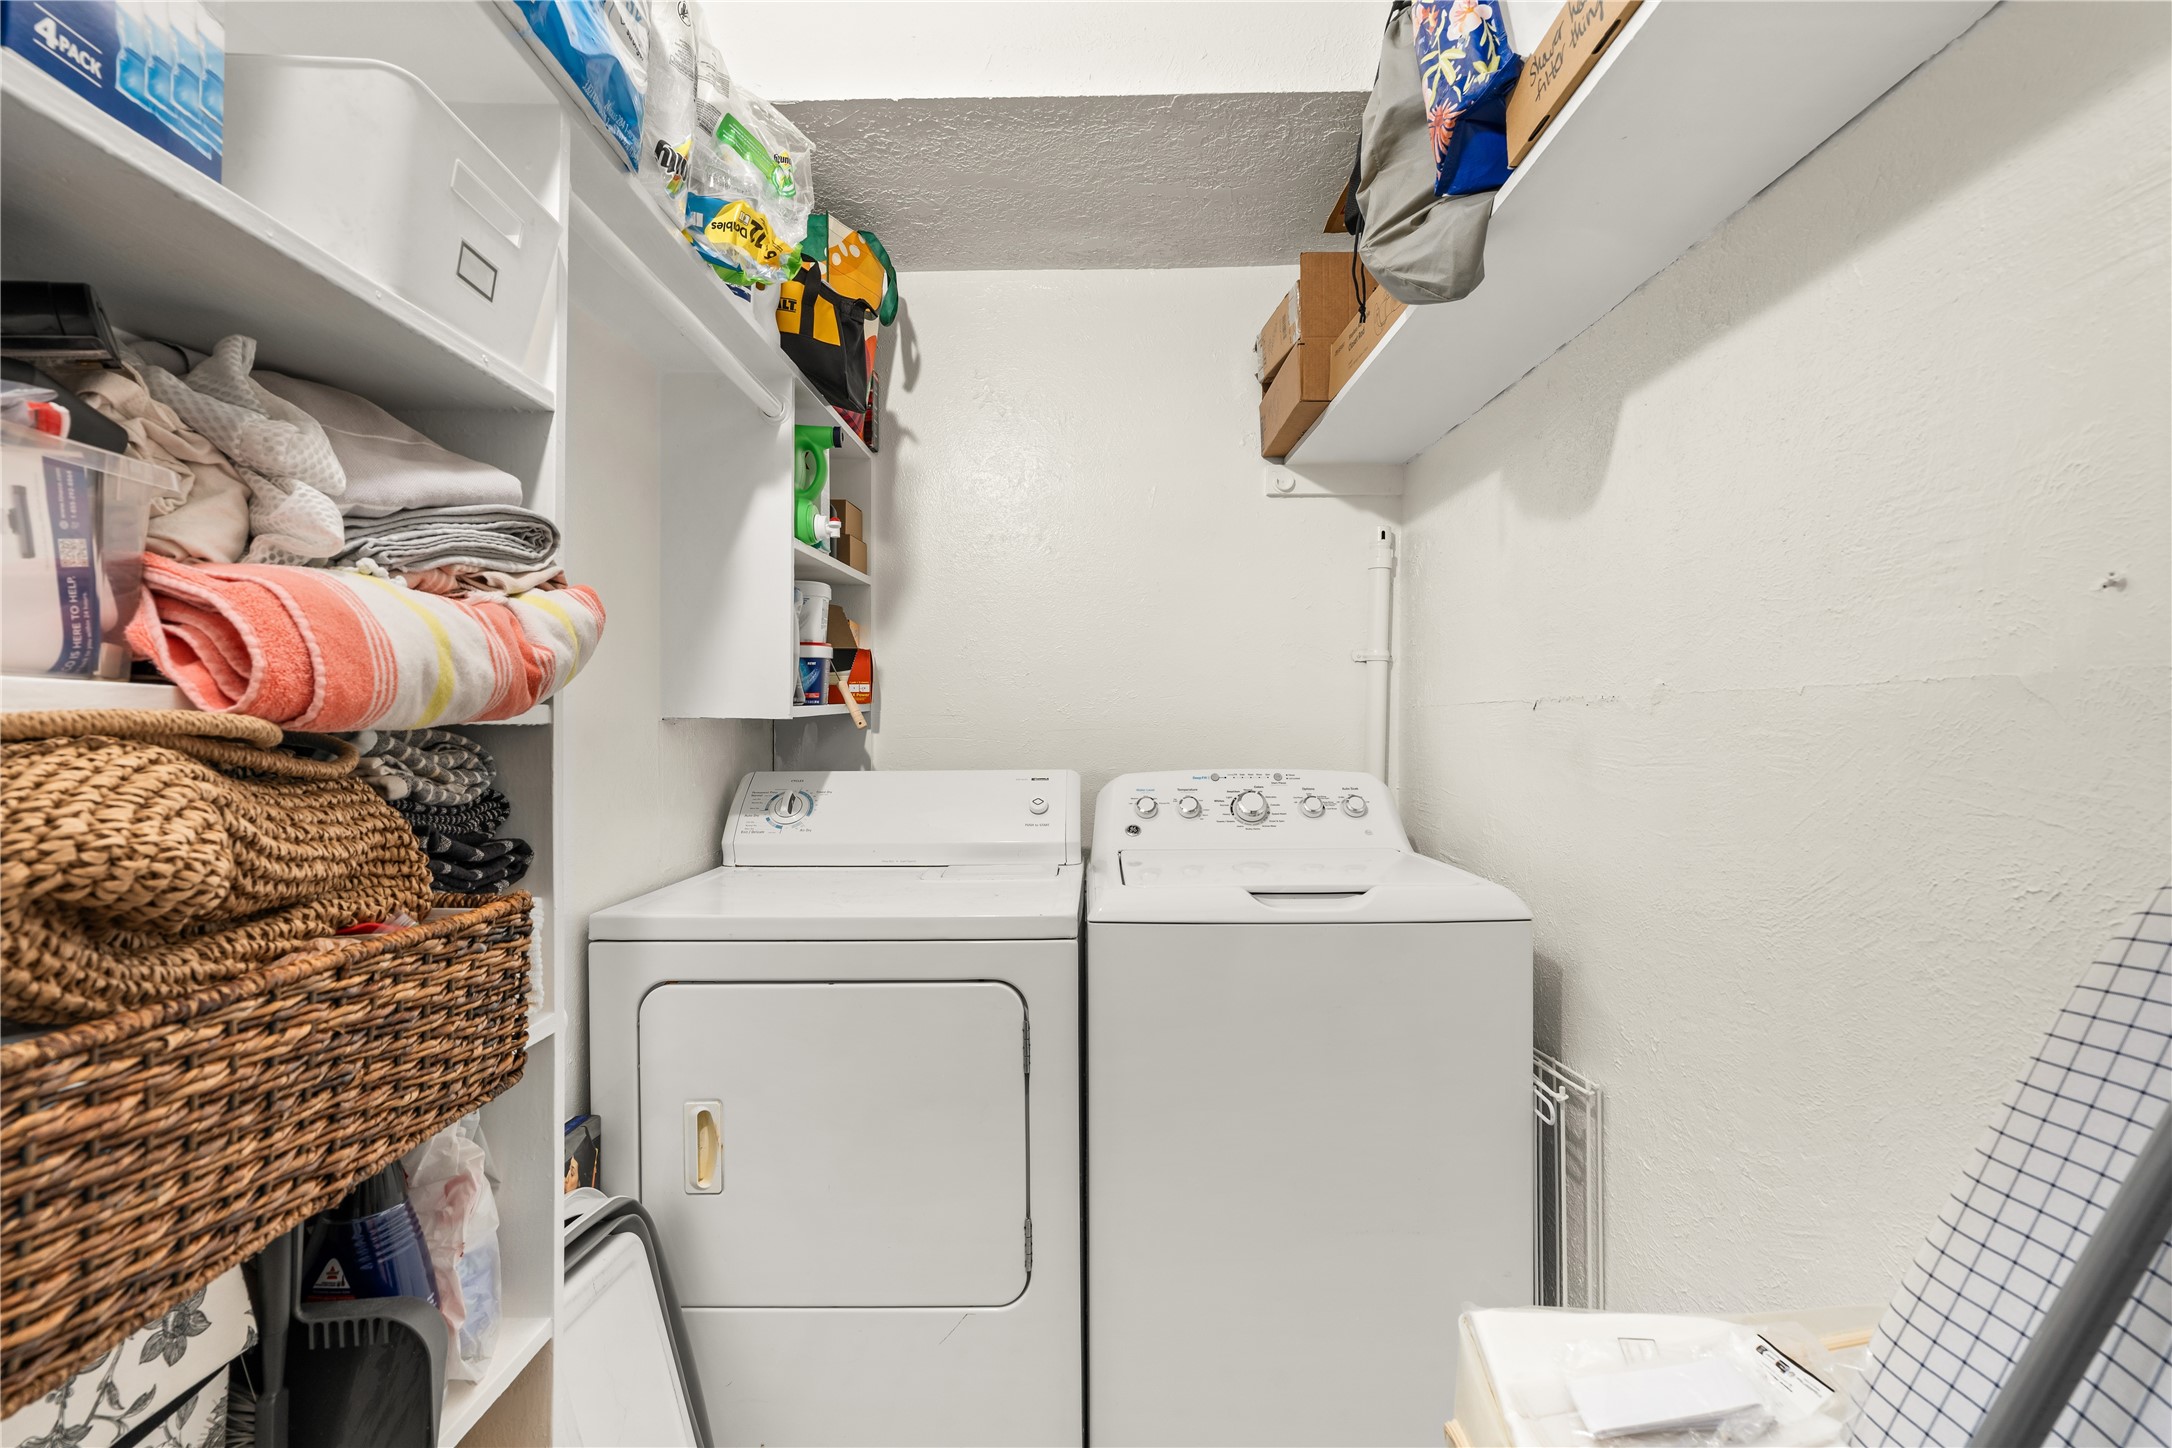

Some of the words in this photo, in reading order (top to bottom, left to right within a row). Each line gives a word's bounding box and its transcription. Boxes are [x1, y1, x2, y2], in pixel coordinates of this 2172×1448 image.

[34, 16, 59, 50] 4
[59, 35, 102, 79] PACK
[749, 219, 767, 249] 12
[70, 604, 81, 621] TO
[71, 622, 83, 649] HERE
